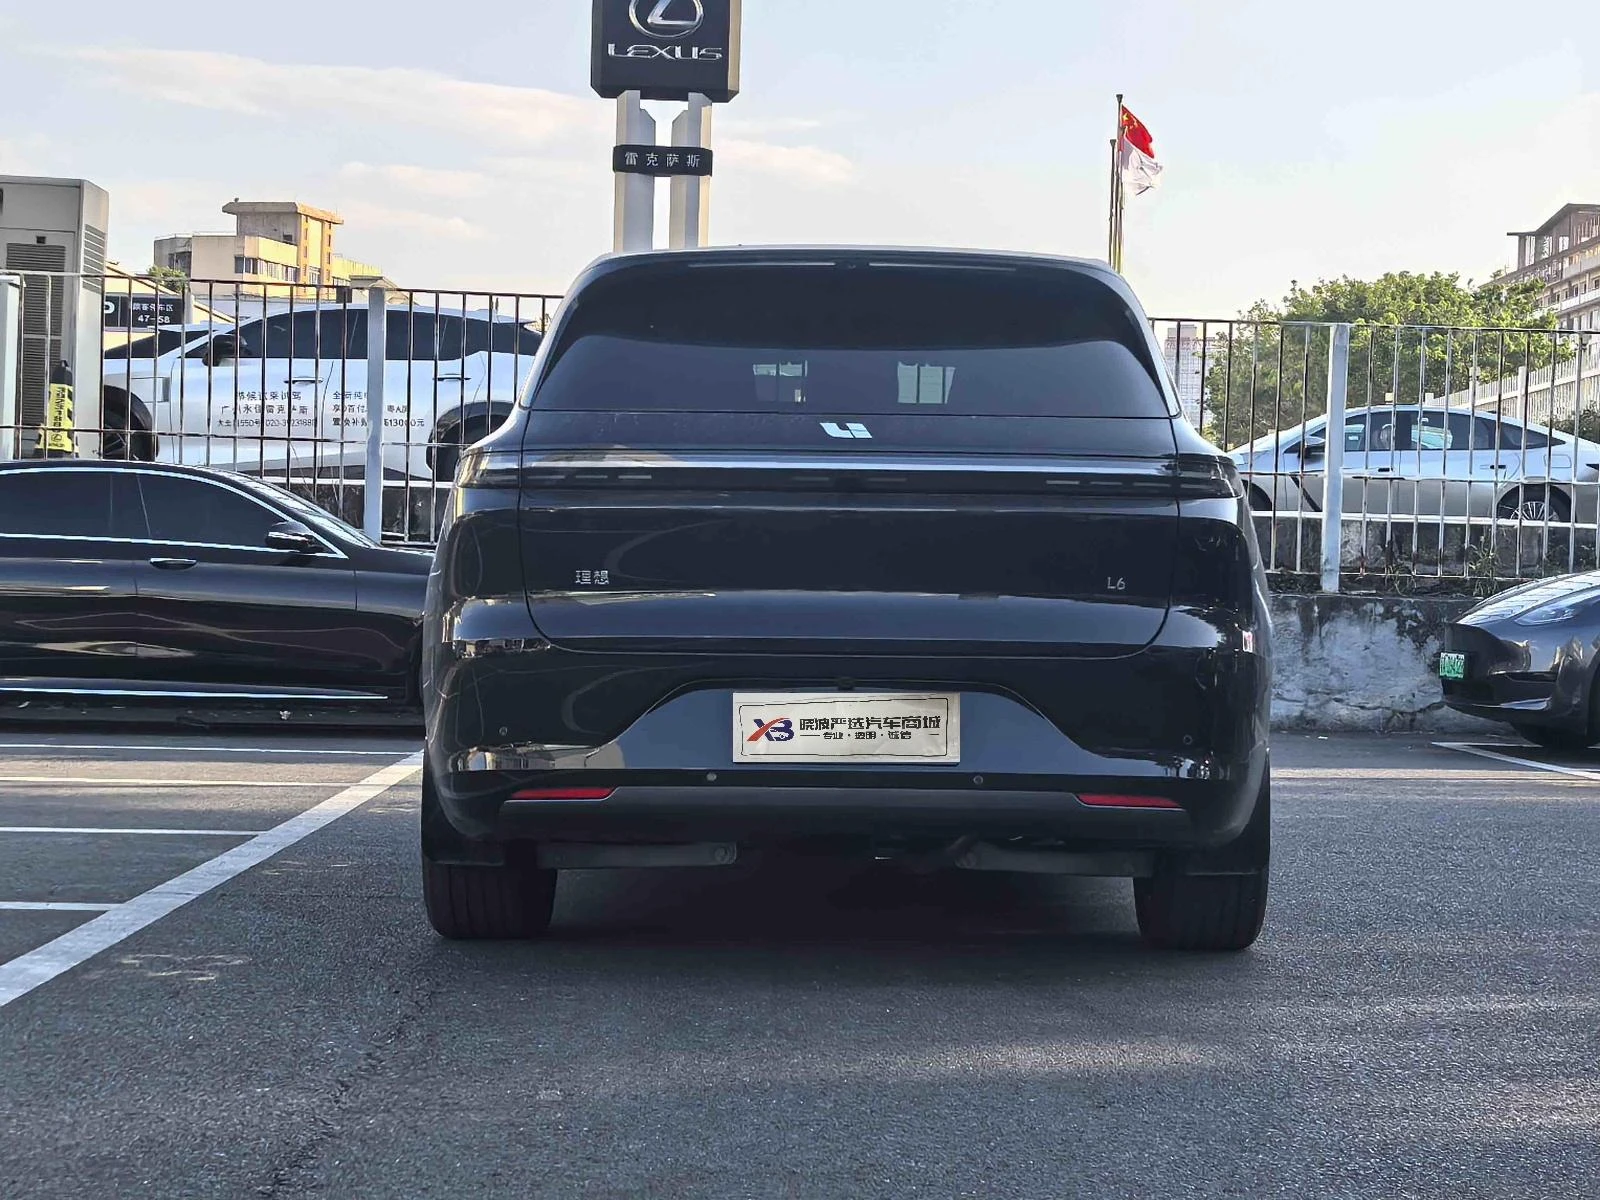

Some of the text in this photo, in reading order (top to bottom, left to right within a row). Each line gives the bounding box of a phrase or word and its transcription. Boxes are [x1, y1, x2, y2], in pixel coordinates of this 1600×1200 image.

[607, 43, 723, 61] LEXUS
[624, 151, 701, 168] 雷克萨斯
[575, 570, 610, 584] 理想
[1107, 576, 1126, 590] L6
